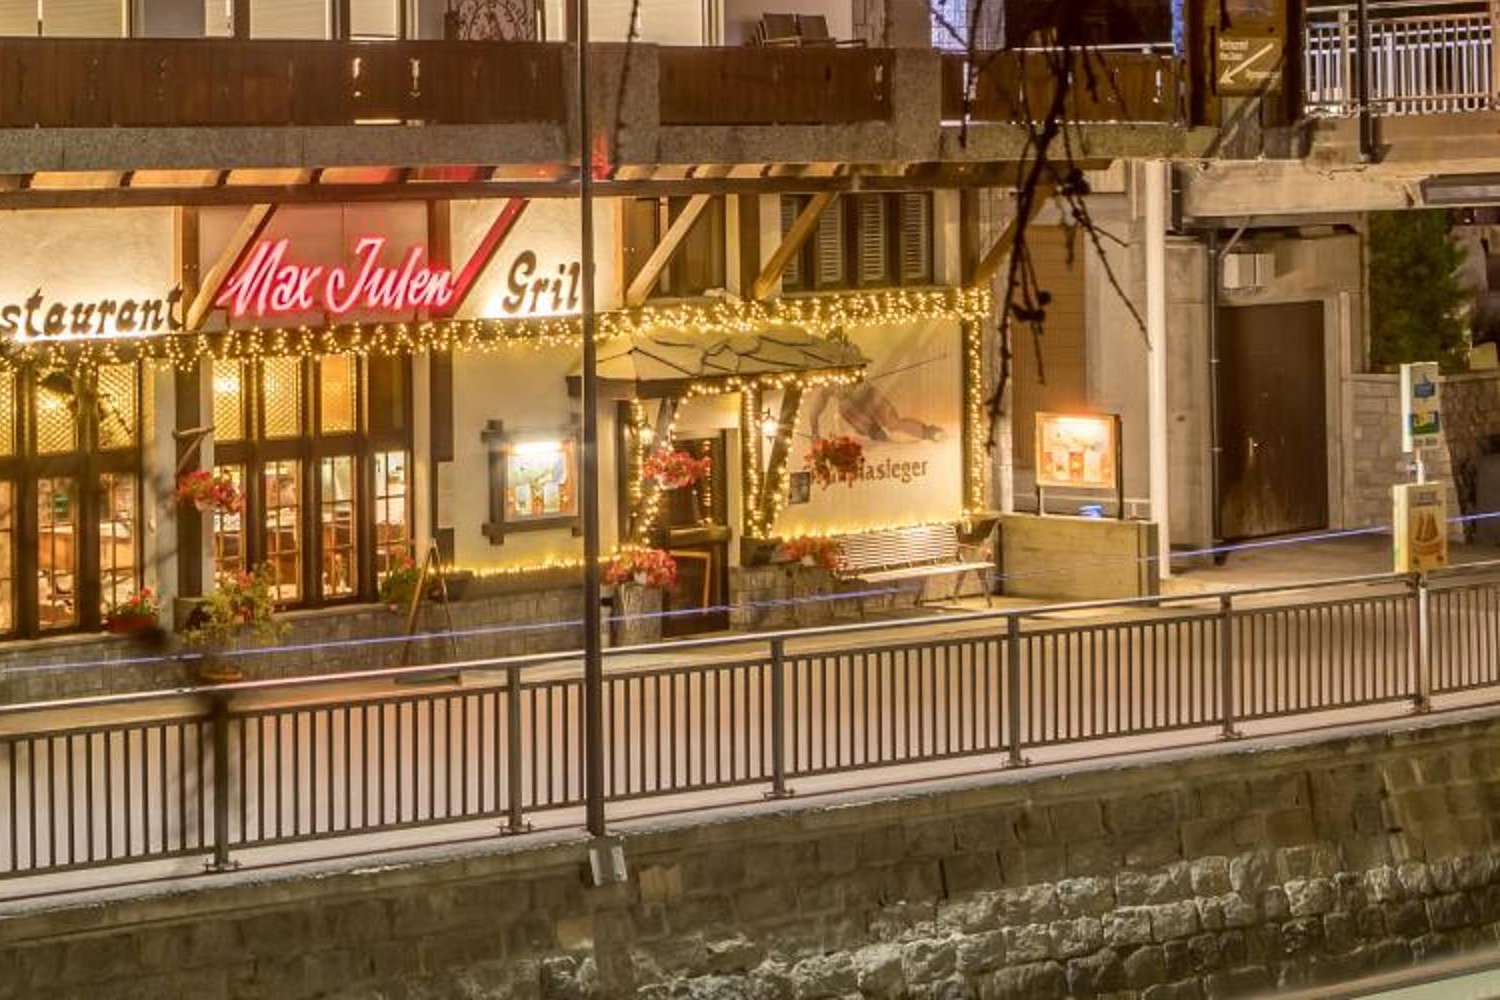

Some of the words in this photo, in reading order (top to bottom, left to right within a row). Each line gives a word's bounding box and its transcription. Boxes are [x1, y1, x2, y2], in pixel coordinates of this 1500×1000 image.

[215, 237, 324, 317] Max
[326, 236, 454, 313] Julen
[502, 249, 596, 314] Gril
